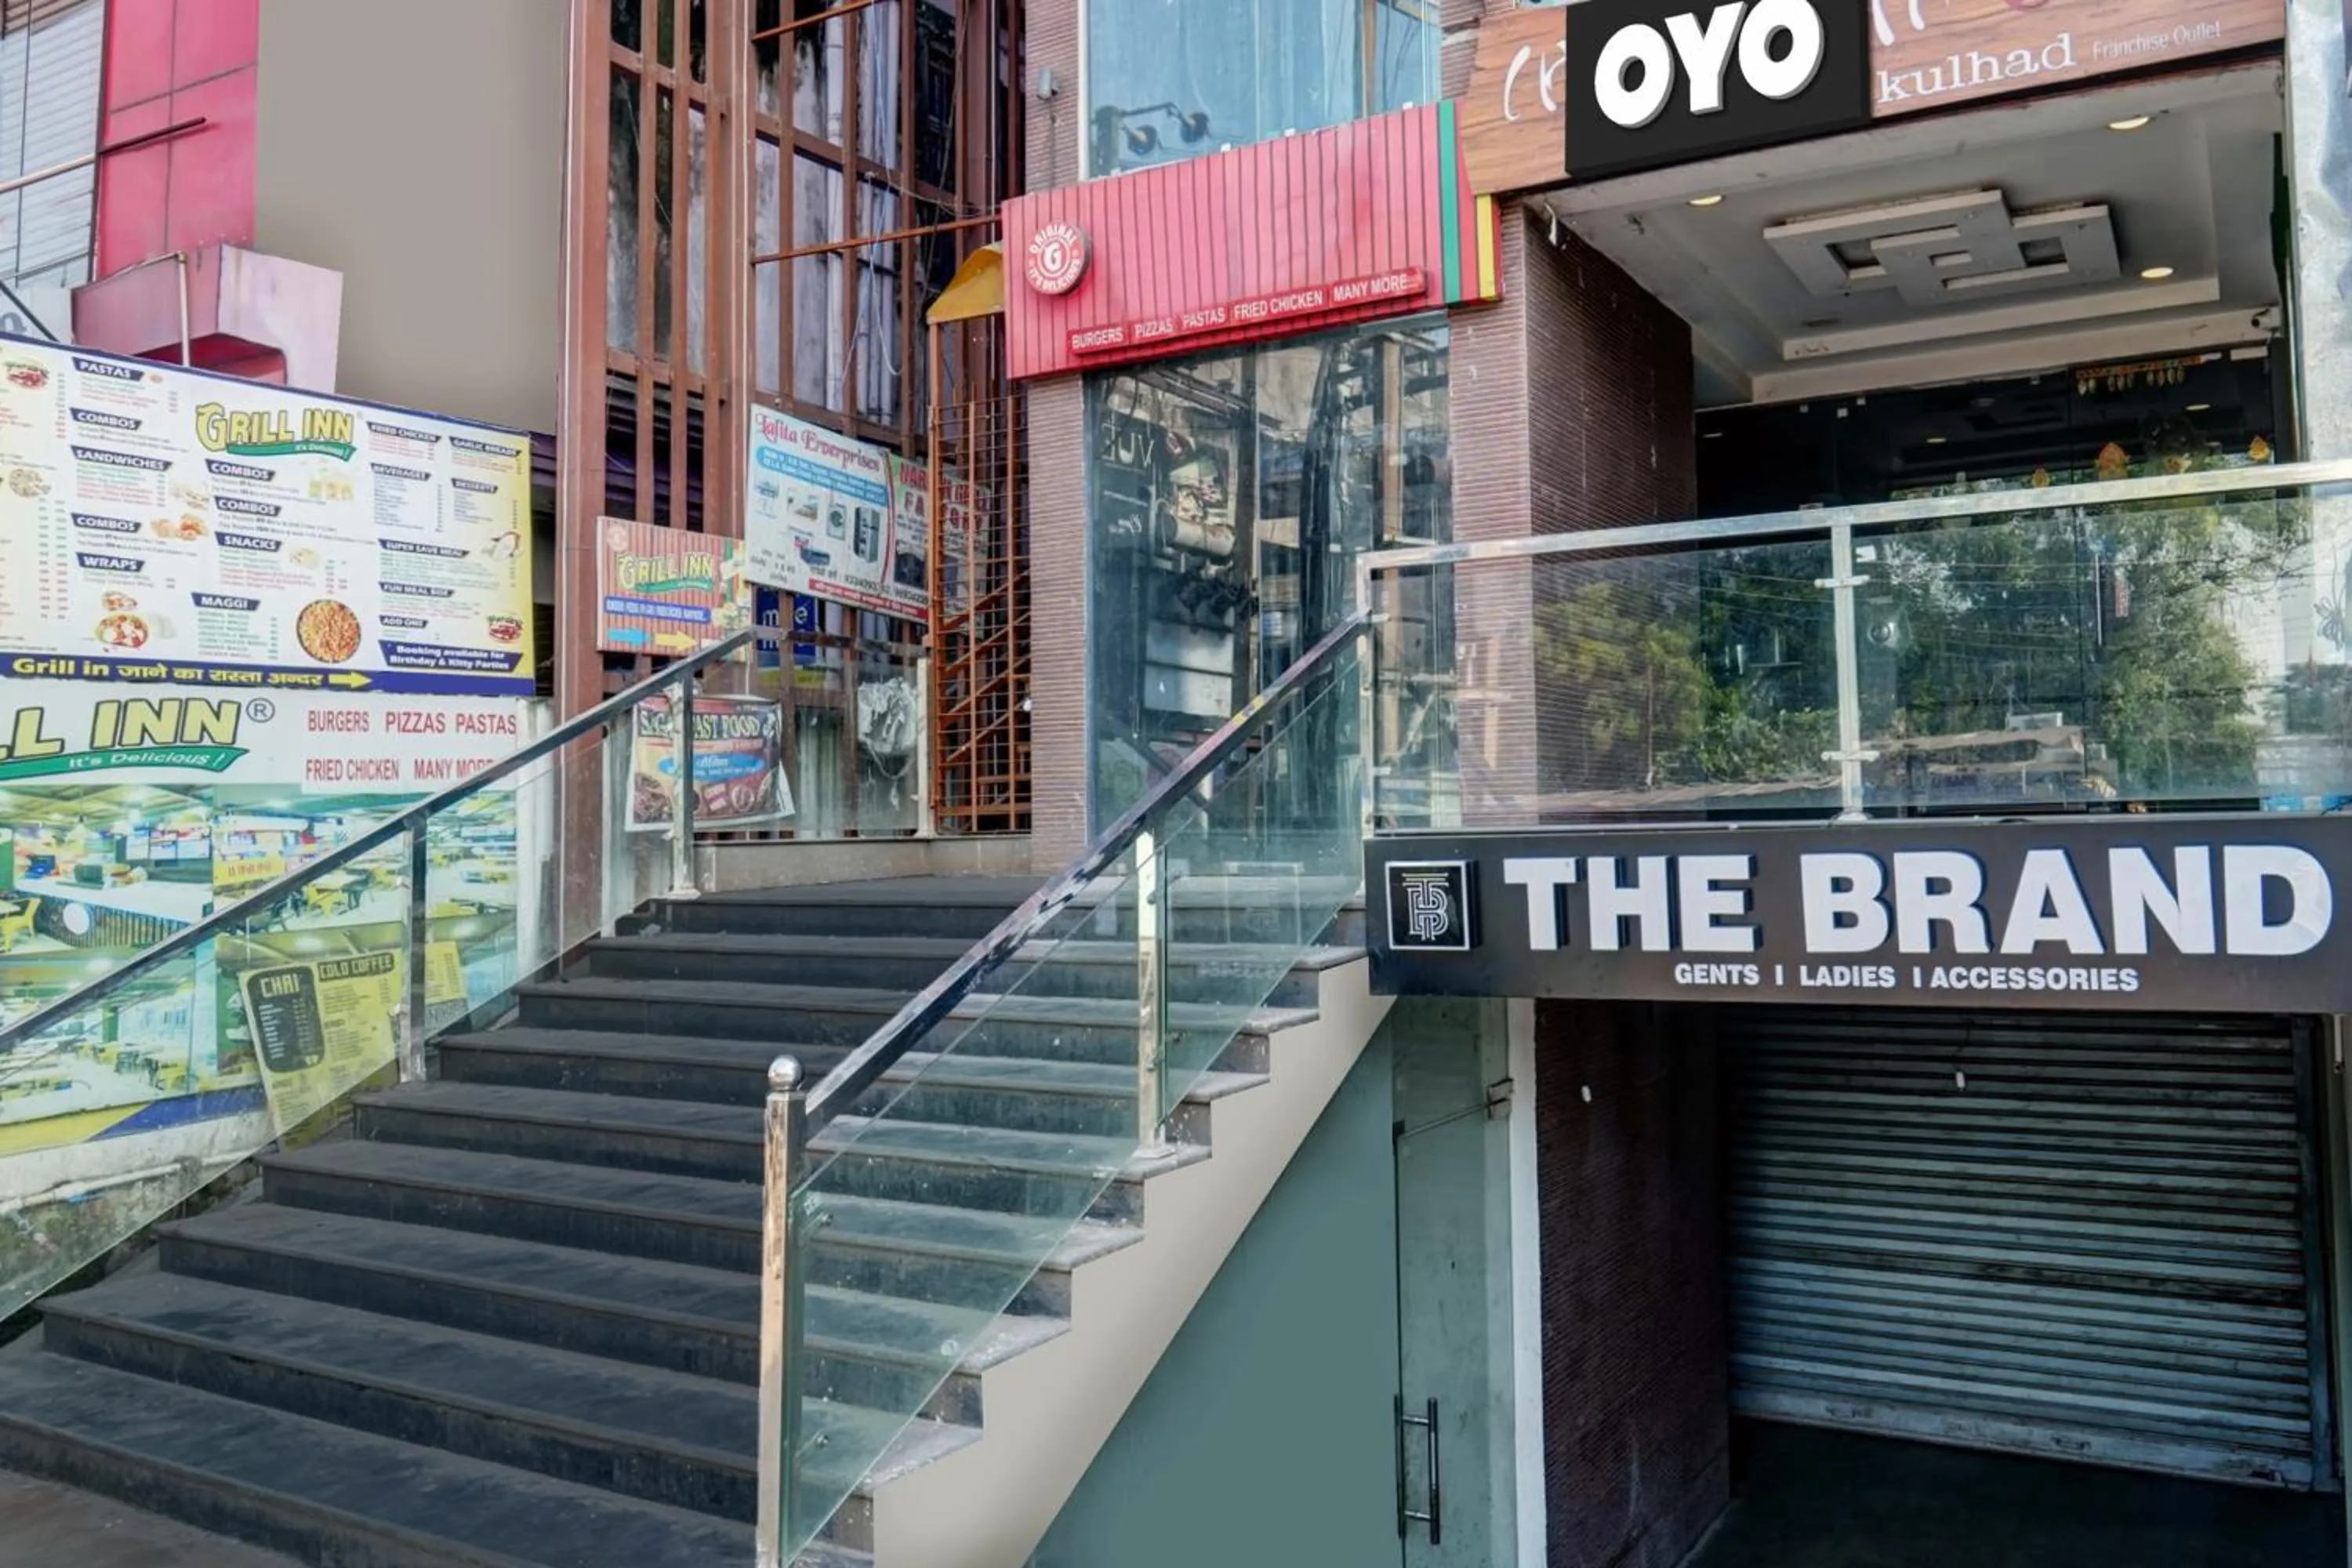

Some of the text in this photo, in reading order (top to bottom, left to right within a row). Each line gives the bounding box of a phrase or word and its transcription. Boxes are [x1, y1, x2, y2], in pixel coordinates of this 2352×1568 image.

[1594, 0, 1824, 129] OYO
[1875, 20, 2220, 103] kulhad Franchise Outlet
[1072, 327, 1123, 350] BURGERS
[1134, 318, 1174, 337] PIZZAS
[1182, 307, 1225, 328] PASTAS
[1233, 299, 1268, 319] FRIED
[1270, 290, 1323, 314] CHICKEN
[1334, 281, 1369, 302] MANY
[80, 360, 132, 379] PASTAS
[78, 412, 136, 430] COMBOS
[195, 401, 295, 452] GRILL
[301, 408, 354, 443] INN
[76, 449, 165, 470] SANDWICHES
[211, 463, 269, 480] COMBOS
[219, 499, 276, 515] COMBOS
[77, 516, 136, 532] COMBOS
[223, 535, 276, 550] SNACKS
[82, 555, 138, 571] WRAPS
[617, 554, 677, 589] GRILL
[684, 552, 713, 579] INN
[201, 596, 249, 610] MAGGI
[397, 644, 441, 658] Booking
[443, 648, 488, 659] available
[13, 658, 75, 676] Grill
[83, 660, 110, 676] in
[90, 698, 241, 750] INN
[308, 710, 517, 735] BURGERS PIZZAS PASTAS
[721, 714, 760, 739] FOOD
[69, 757, 102, 769] It's
[110, 752, 209, 766] Delicious
[306, 758, 495, 781] FRIED CHICKEN MANY MOR
[1503, 844, 2334, 956] THE BRAND
[318, 954, 393, 980] COLD COFFEE
[1675, 963, 1761, 986] GENTS
[1799, 964, 1896, 989] LADIES
[1930, 966, 2140, 993] ACCESSORIES
[260, 973, 300, 998] CHAI
